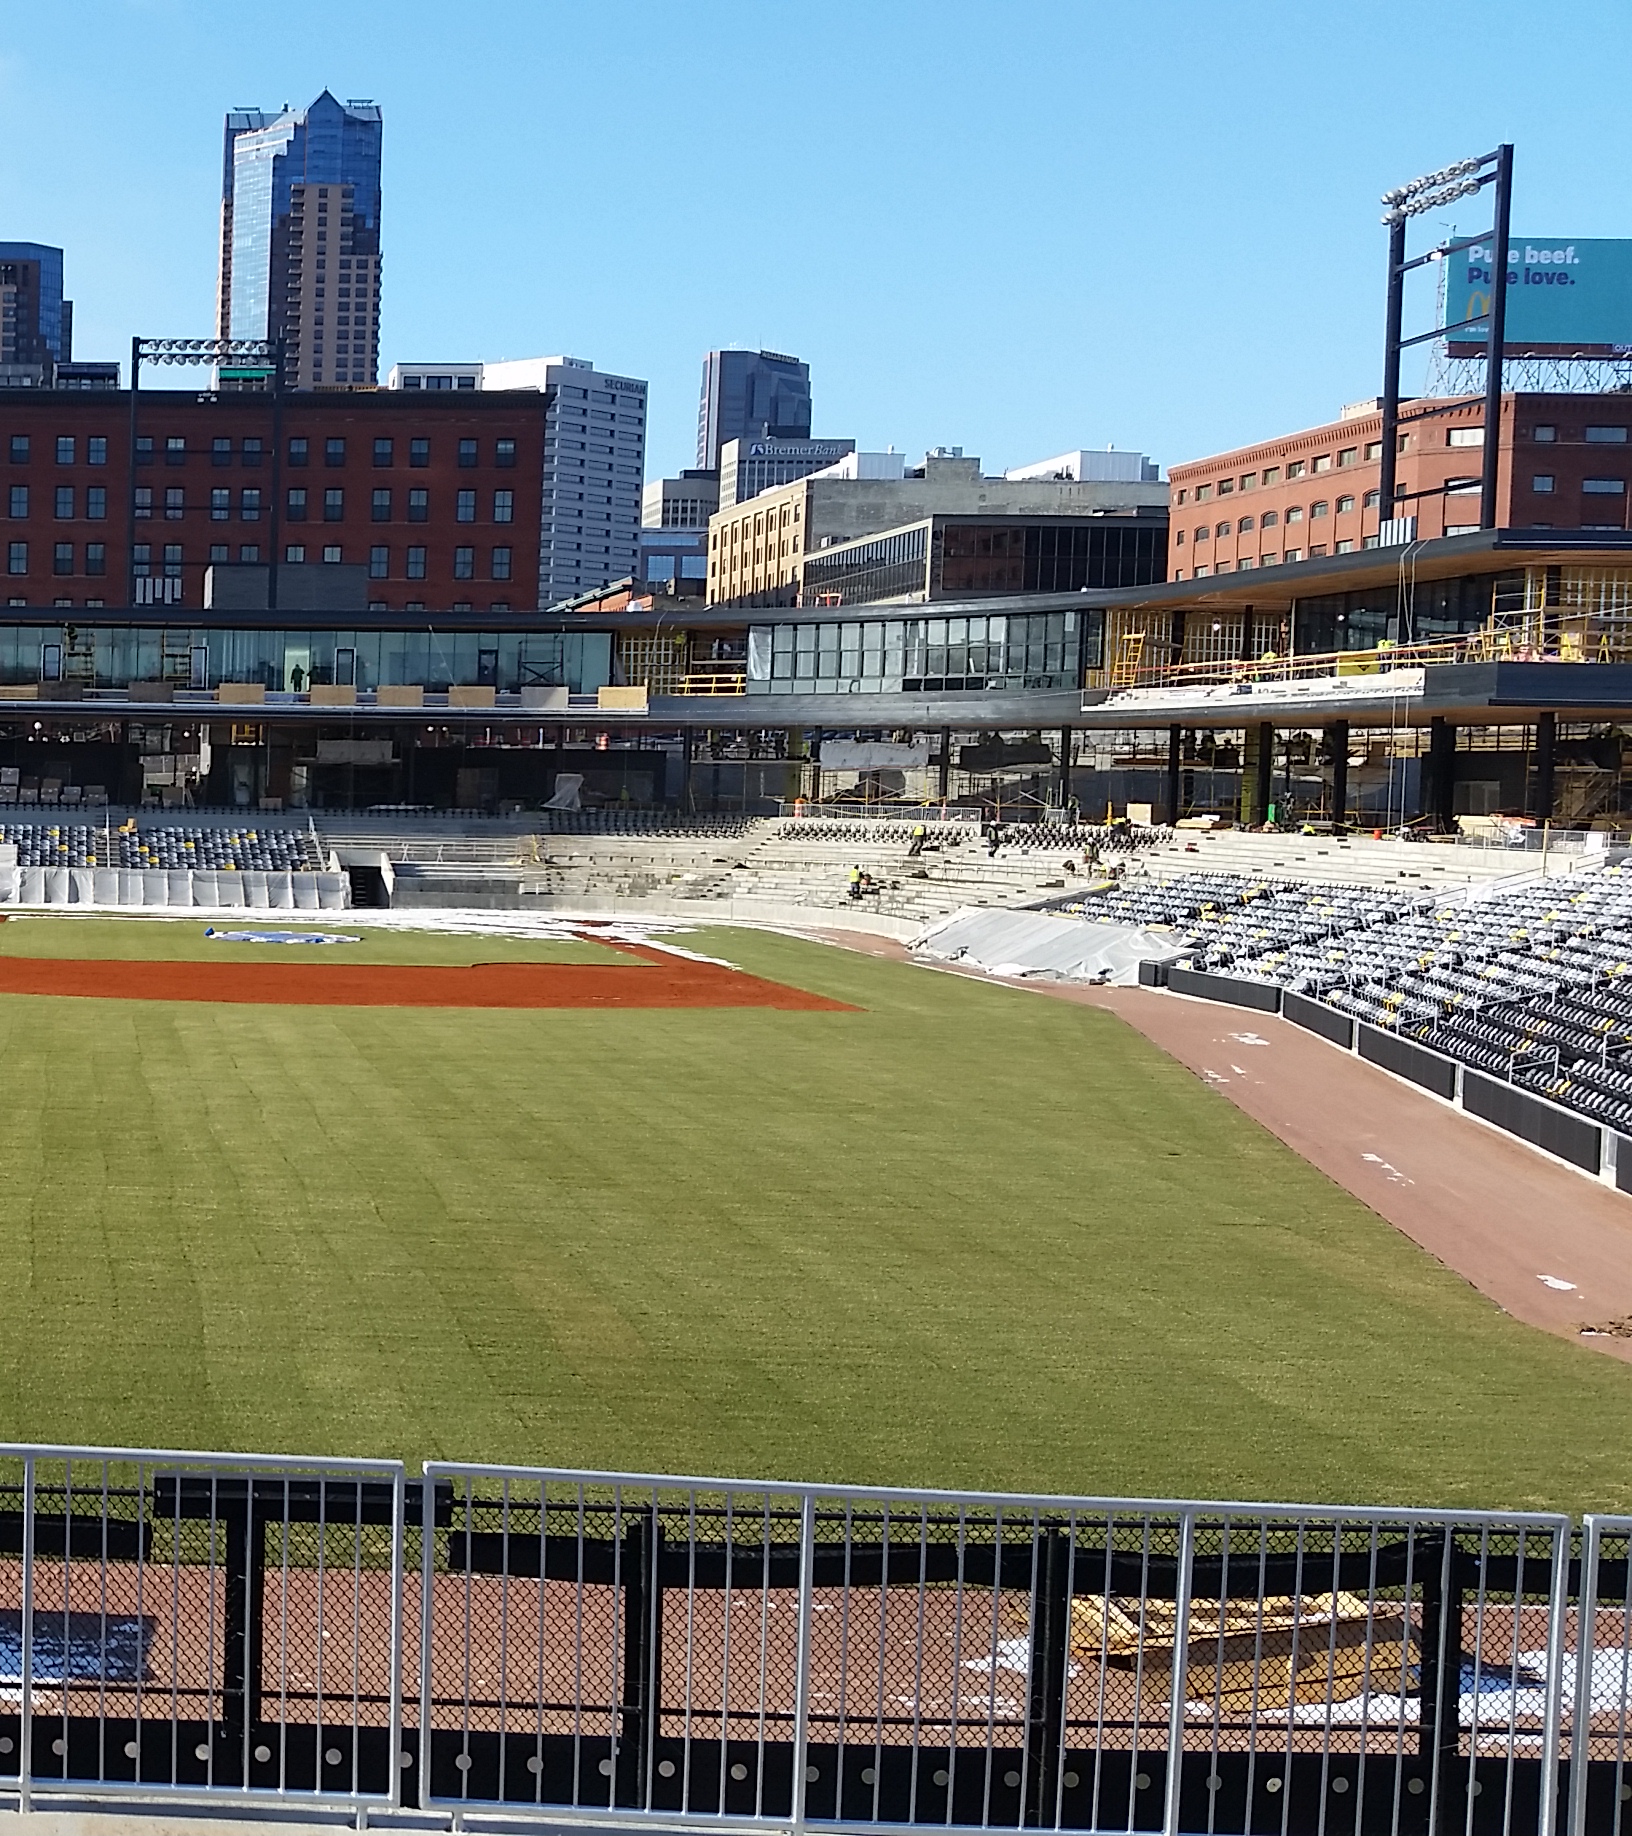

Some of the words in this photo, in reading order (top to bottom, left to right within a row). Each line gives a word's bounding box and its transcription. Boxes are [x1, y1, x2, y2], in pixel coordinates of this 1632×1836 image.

[1468, 245, 1519, 263] Pue
[1525, 245, 1579, 264] beef.
[1468, 267, 1518, 284] Pue
[1524, 267, 1575, 285] love.
